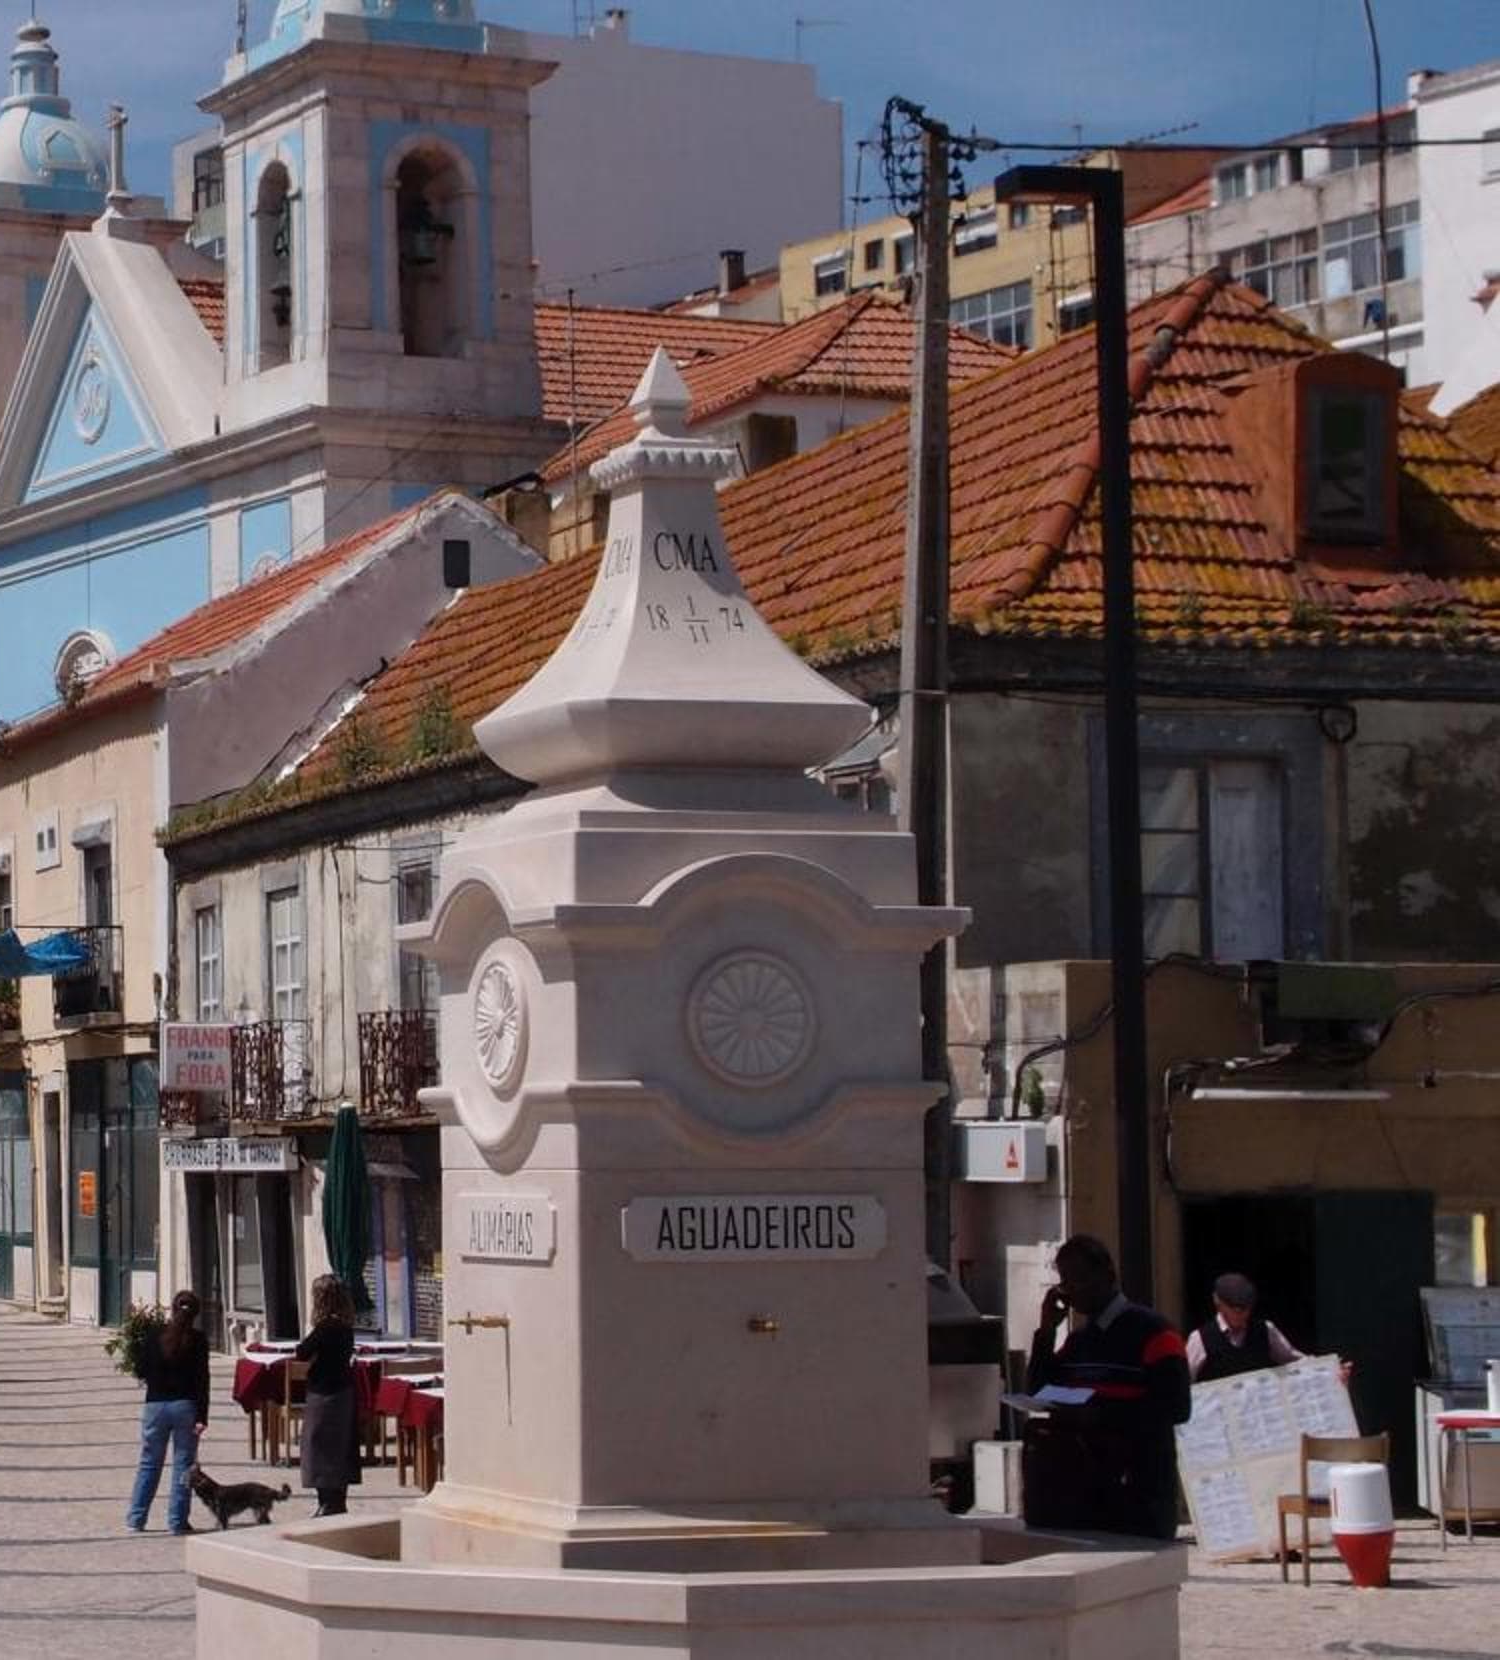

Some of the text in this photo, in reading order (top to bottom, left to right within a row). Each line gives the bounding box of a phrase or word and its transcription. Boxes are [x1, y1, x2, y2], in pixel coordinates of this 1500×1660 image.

[654, 531, 718, 573] CMA
[646, 604, 671, 631] 18
[718, 606, 744, 633] 74
[187, 1051, 214, 1061] PARA
[176, 1063, 228, 1085] FORA
[468, 1201, 534, 1256] ALIMÁRIAS
[656, 1205, 856, 1251] AGUADEIROS
